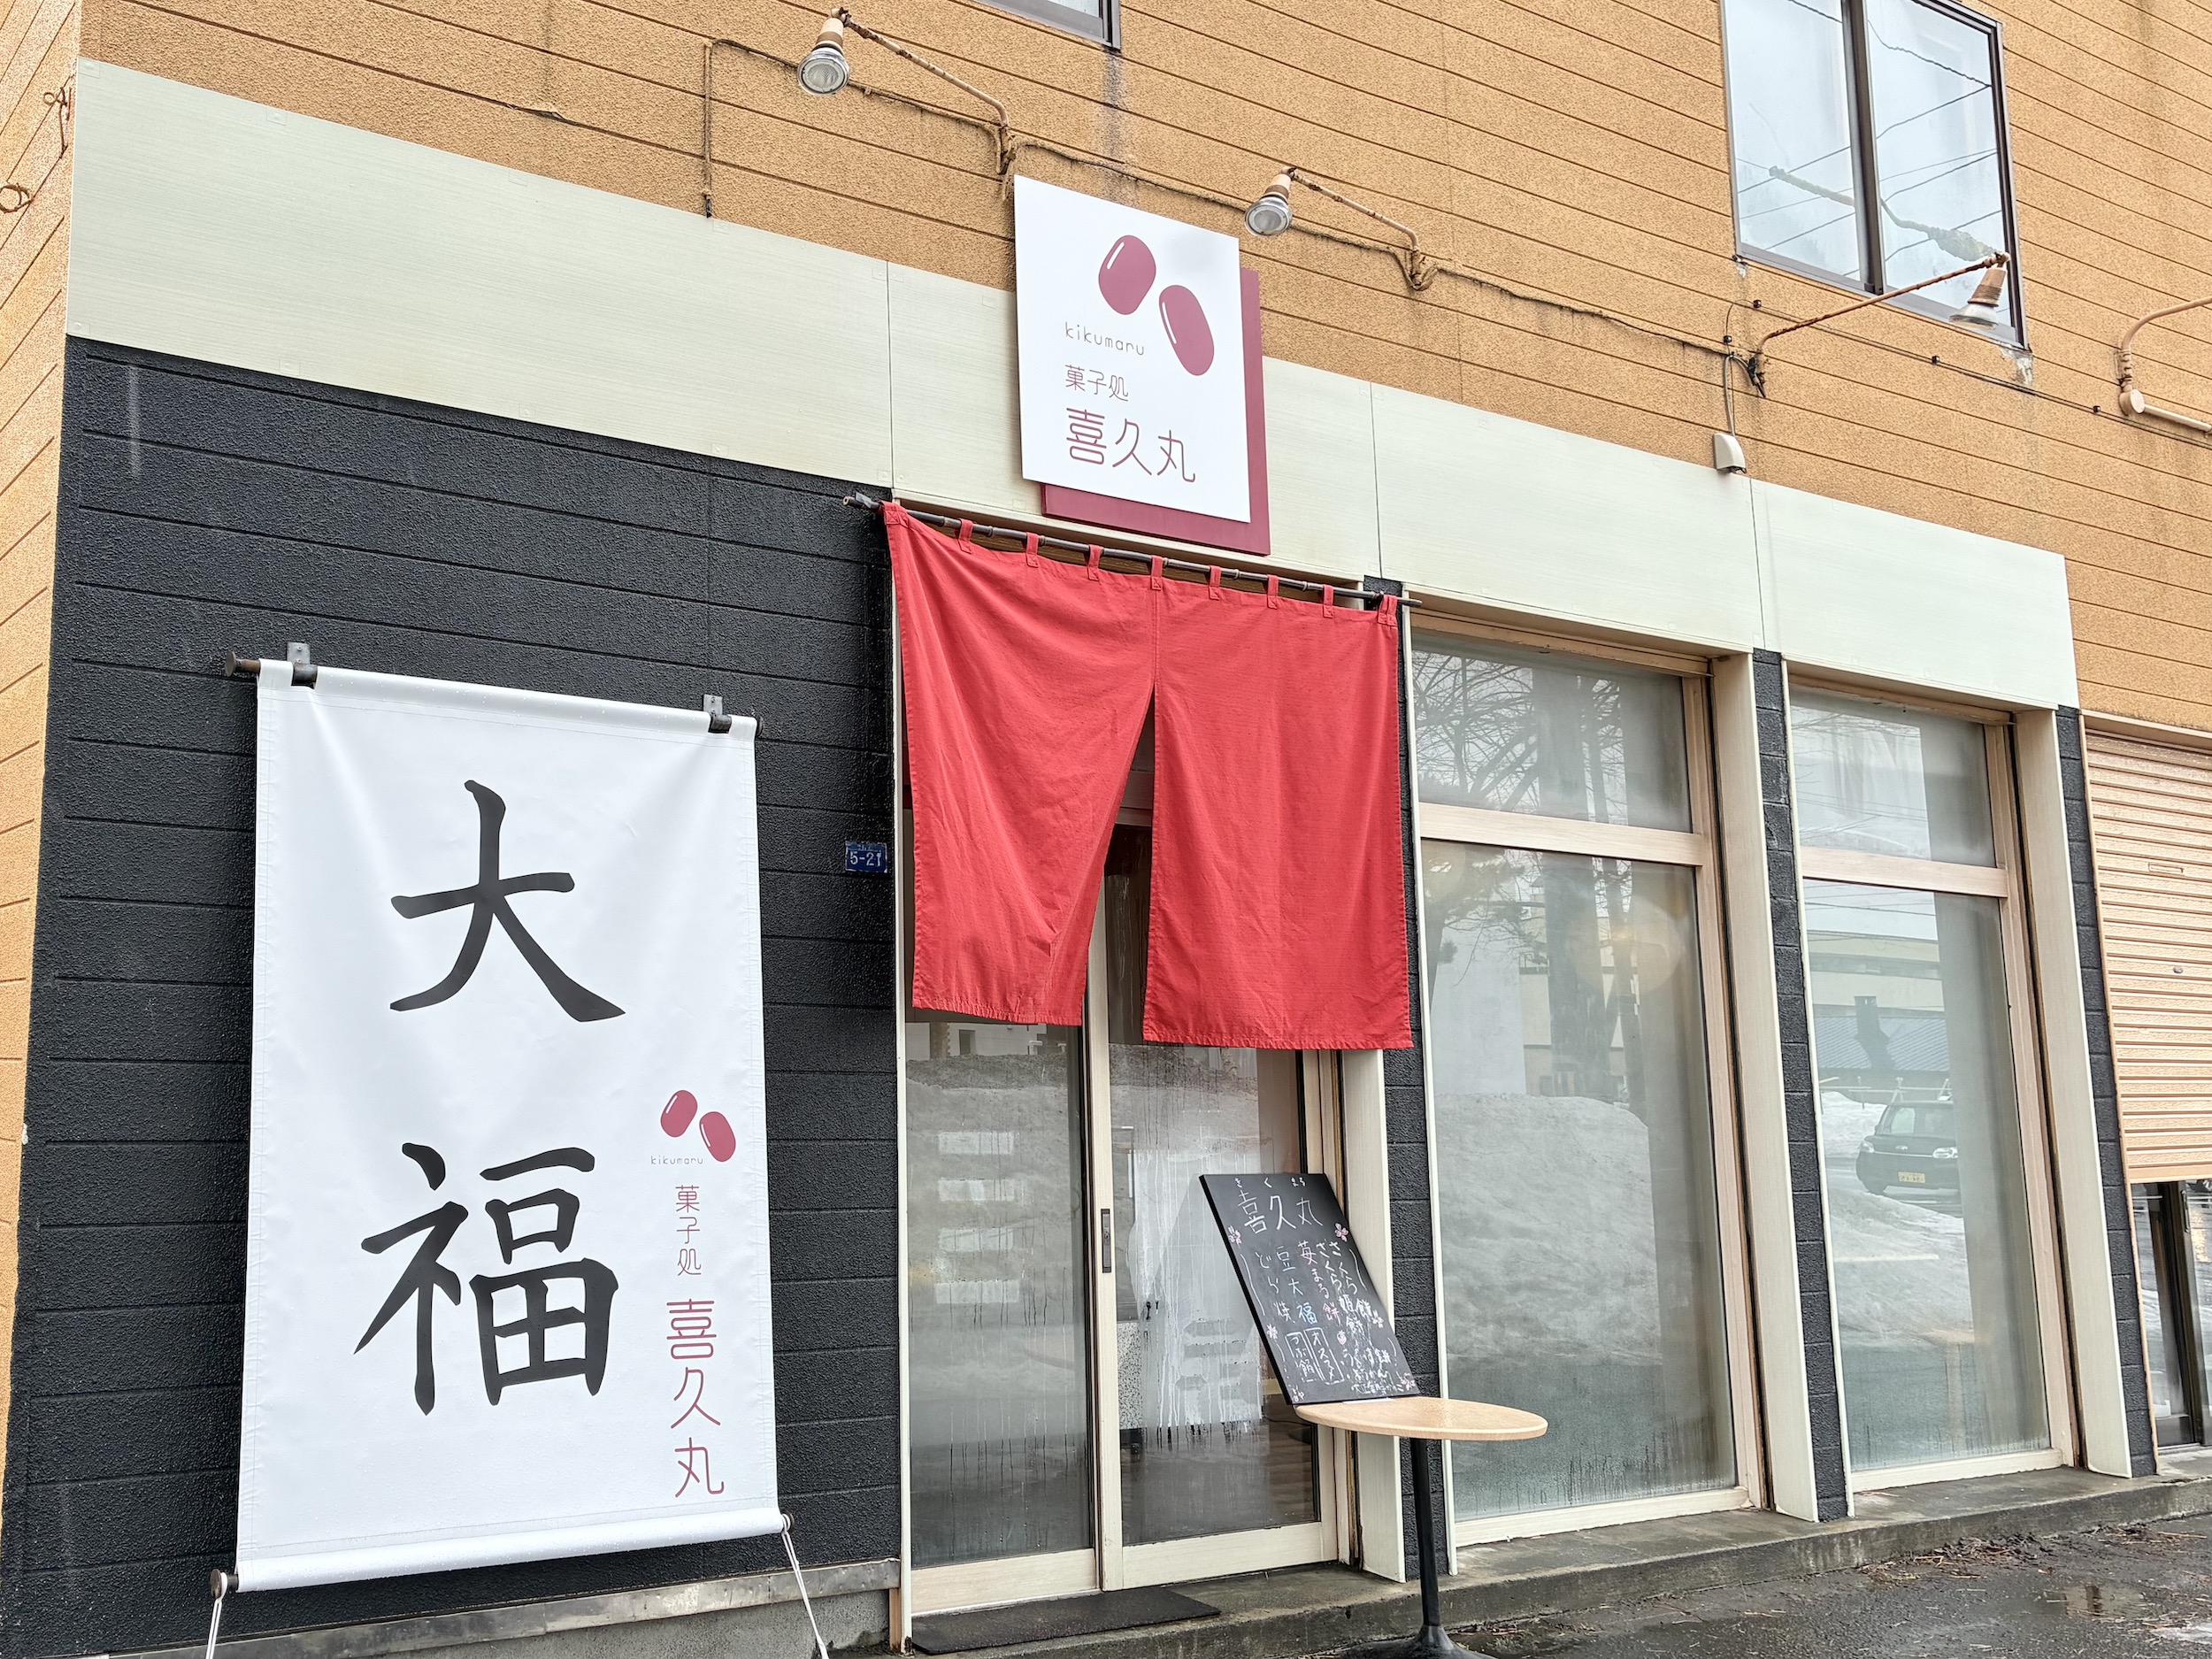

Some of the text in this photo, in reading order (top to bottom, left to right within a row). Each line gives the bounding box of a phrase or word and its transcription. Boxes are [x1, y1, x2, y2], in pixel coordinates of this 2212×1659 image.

[1064, 322, 1145, 356] kikumaru
[1064, 365, 1129, 402] 菓子処
[1066, 408, 1196, 483] 喜久丸
[849, 850, 882, 866] 5-21
[354, 780, 626, 1416] 大福
[650, 1156, 703, 1165] kikumaru
[675, 1185, 702, 1277] 菓子処
[1237, 1189, 1324, 1234] 喜久丸
[1276, 1245, 1318, 1325] 豆大福
[1311, 1331, 1334, 1381] オススメ
[666, 1298, 725, 1498] 喜久丸
